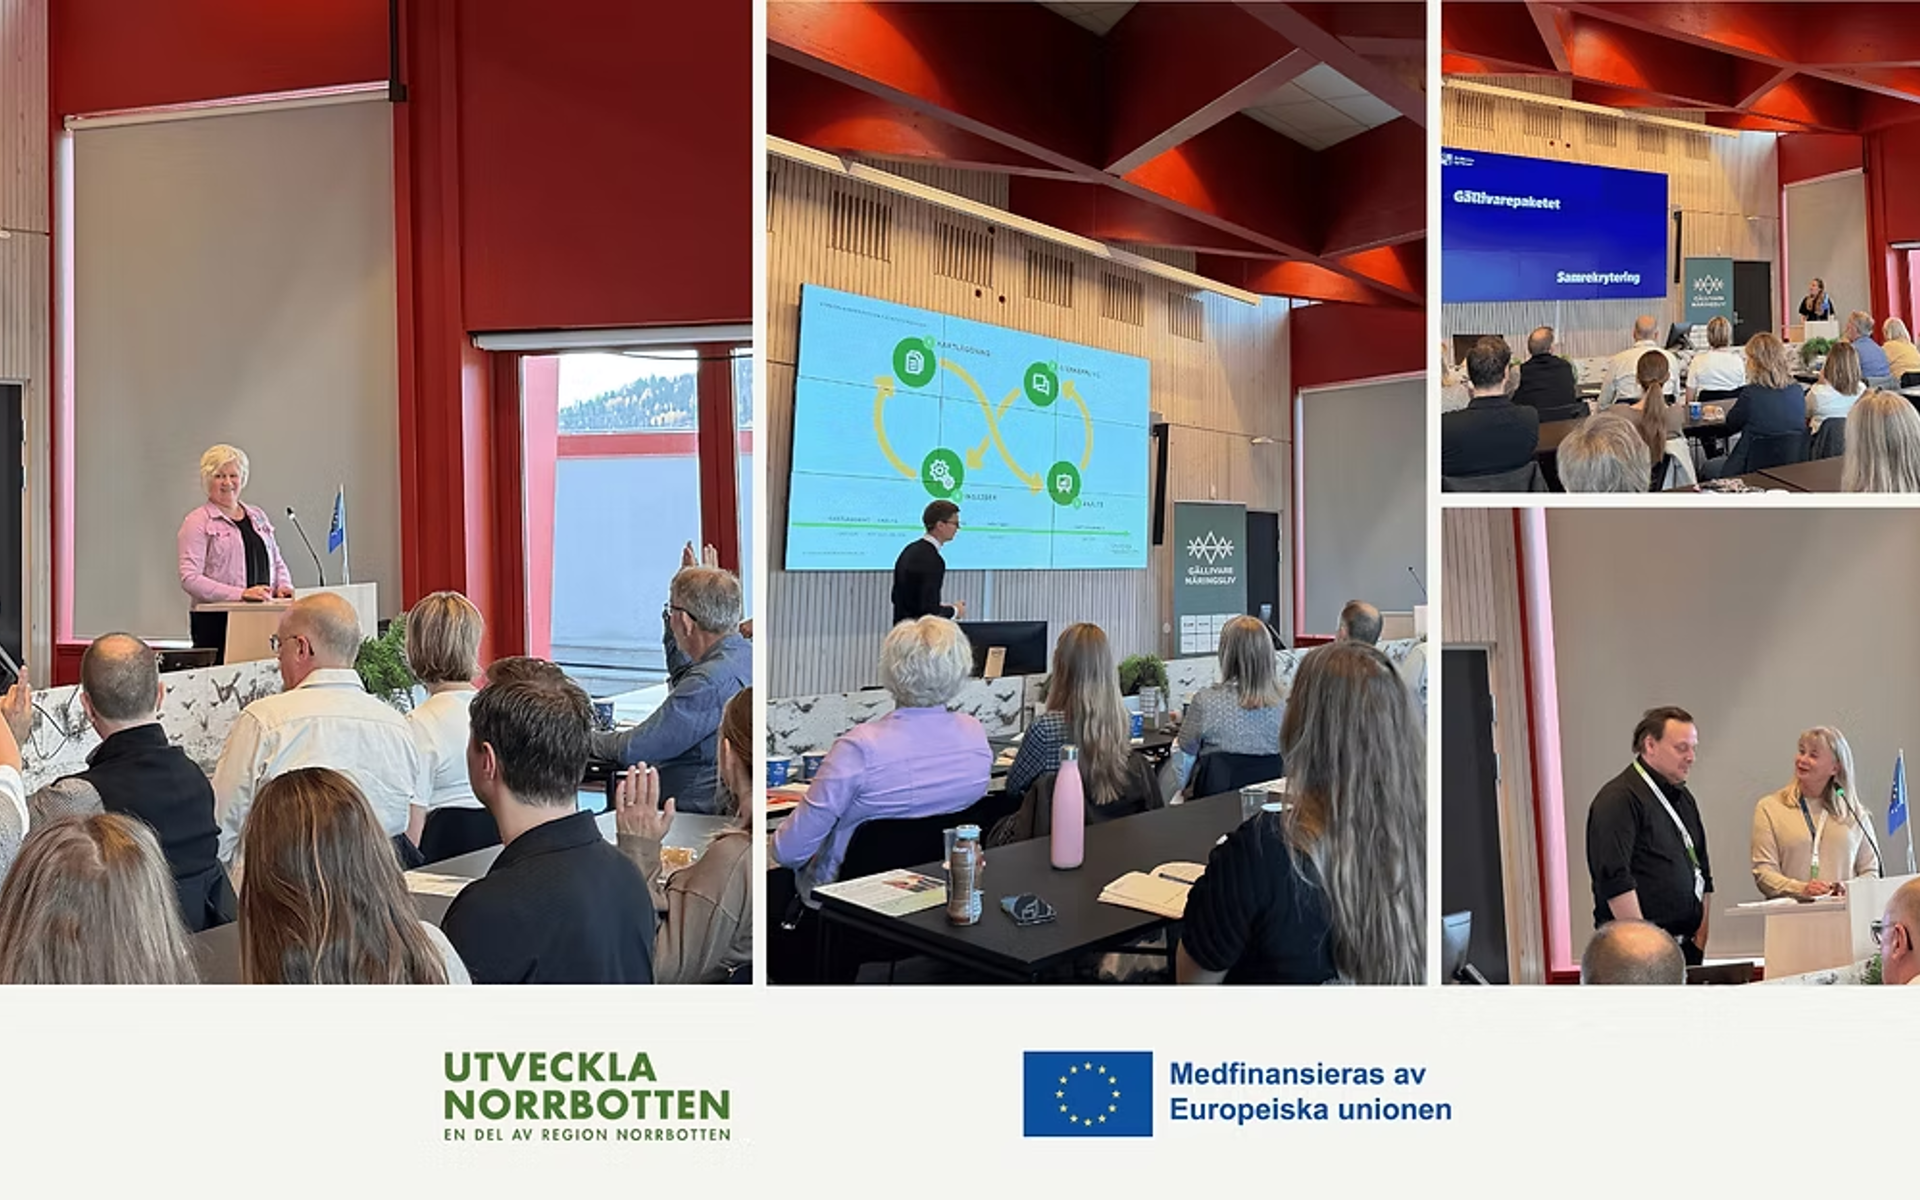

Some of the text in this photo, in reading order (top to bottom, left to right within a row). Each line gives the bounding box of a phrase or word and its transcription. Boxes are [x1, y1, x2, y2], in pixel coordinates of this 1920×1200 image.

[1454, 189, 1562, 210] Gällivarepaketet
[1556, 270, 1641, 286] Samrekrytering
[1187, 564, 1234, 575] GÄLLIVARE
[1184, 574, 1237, 585] NÄRINGSLIV
